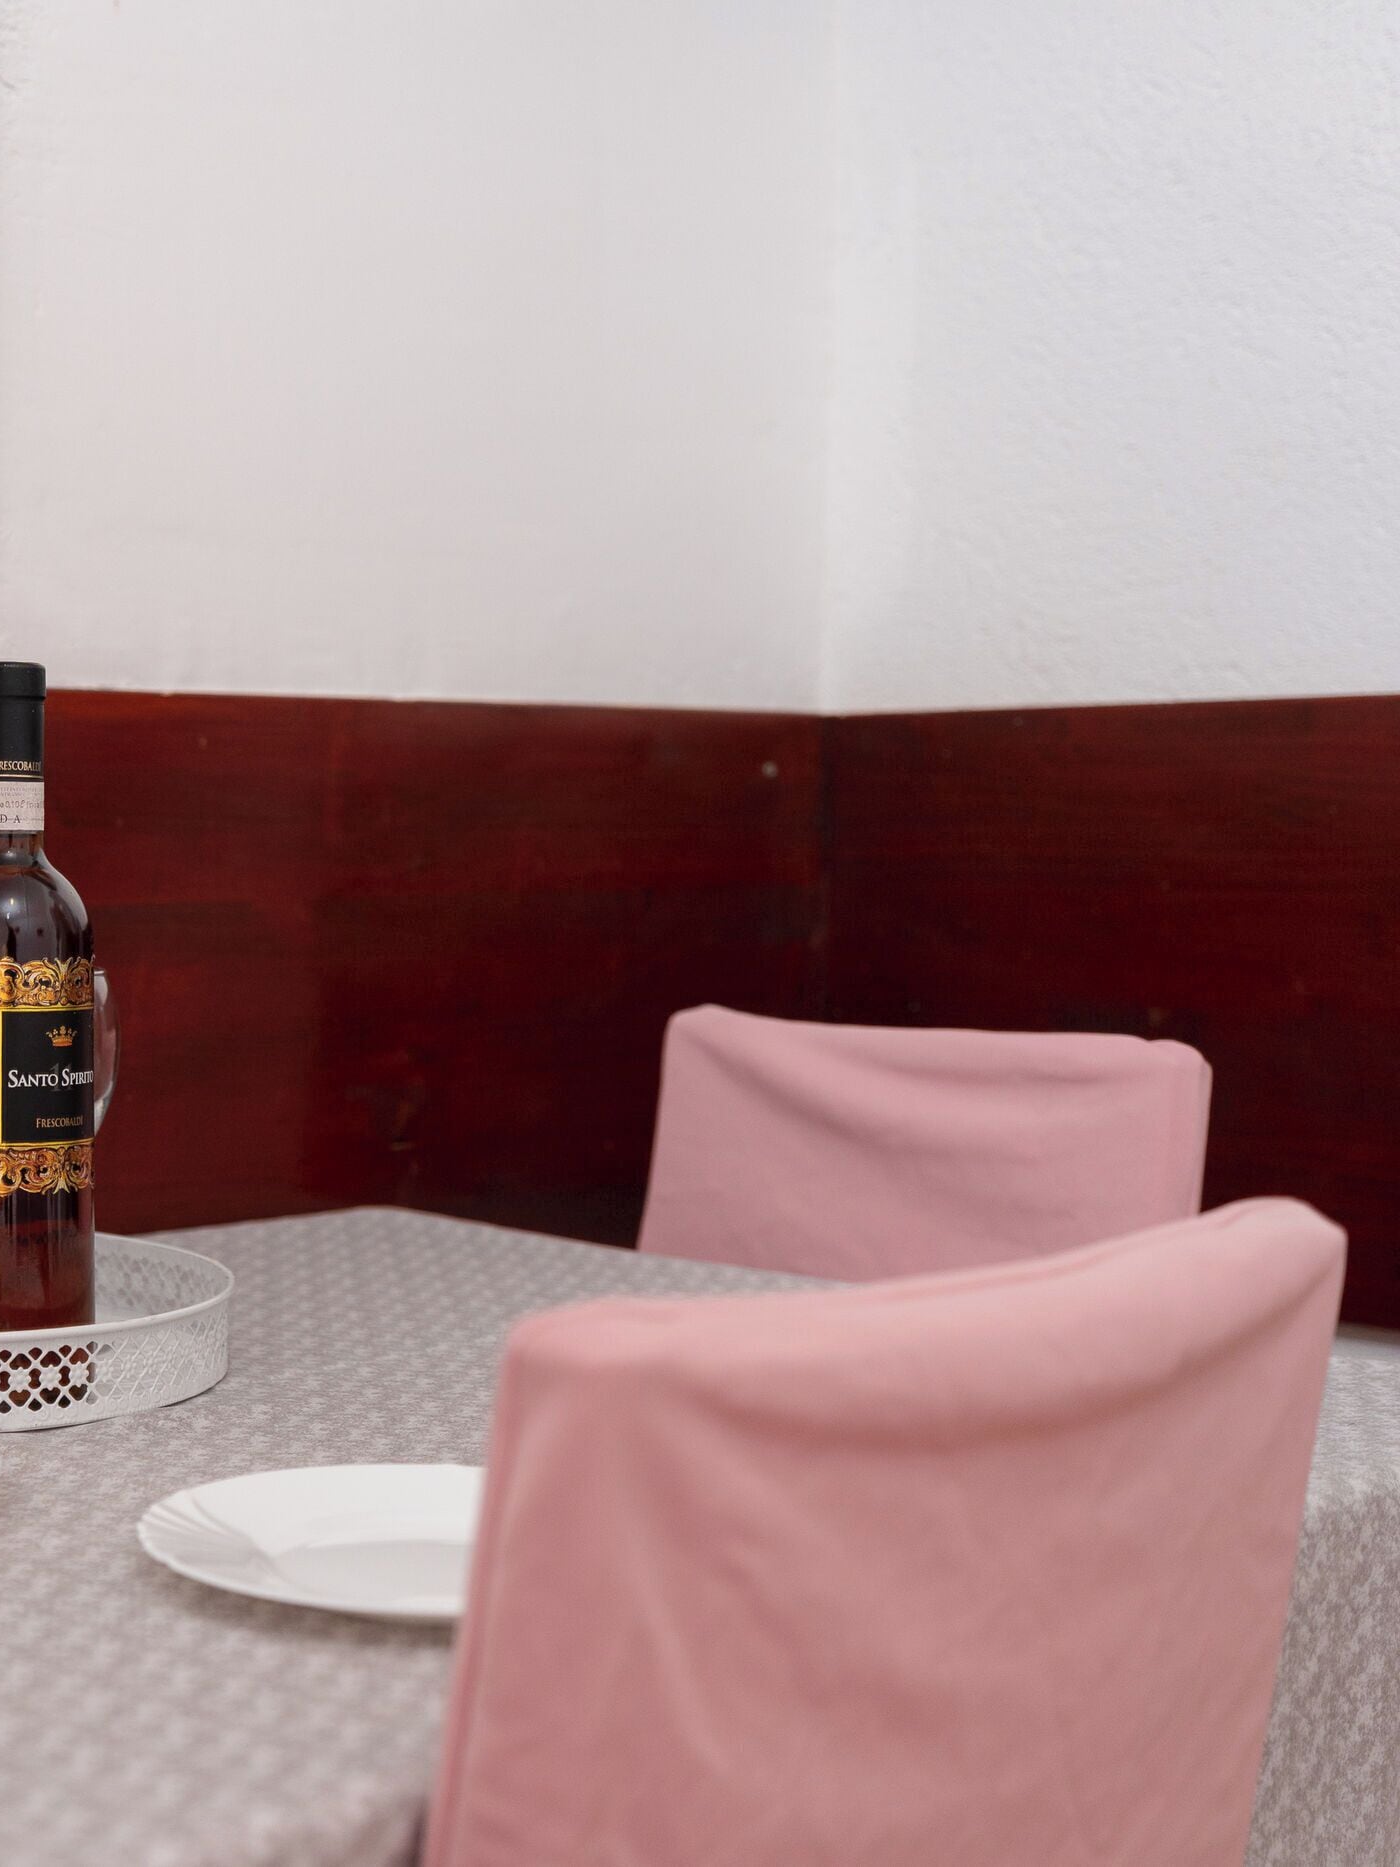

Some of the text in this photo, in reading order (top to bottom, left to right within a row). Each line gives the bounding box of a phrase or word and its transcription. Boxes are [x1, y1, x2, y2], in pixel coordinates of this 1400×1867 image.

[7, 1068, 94, 1088] SANTO SPIRITO
[36, 1116, 83, 1129] FRESCOBALDI
